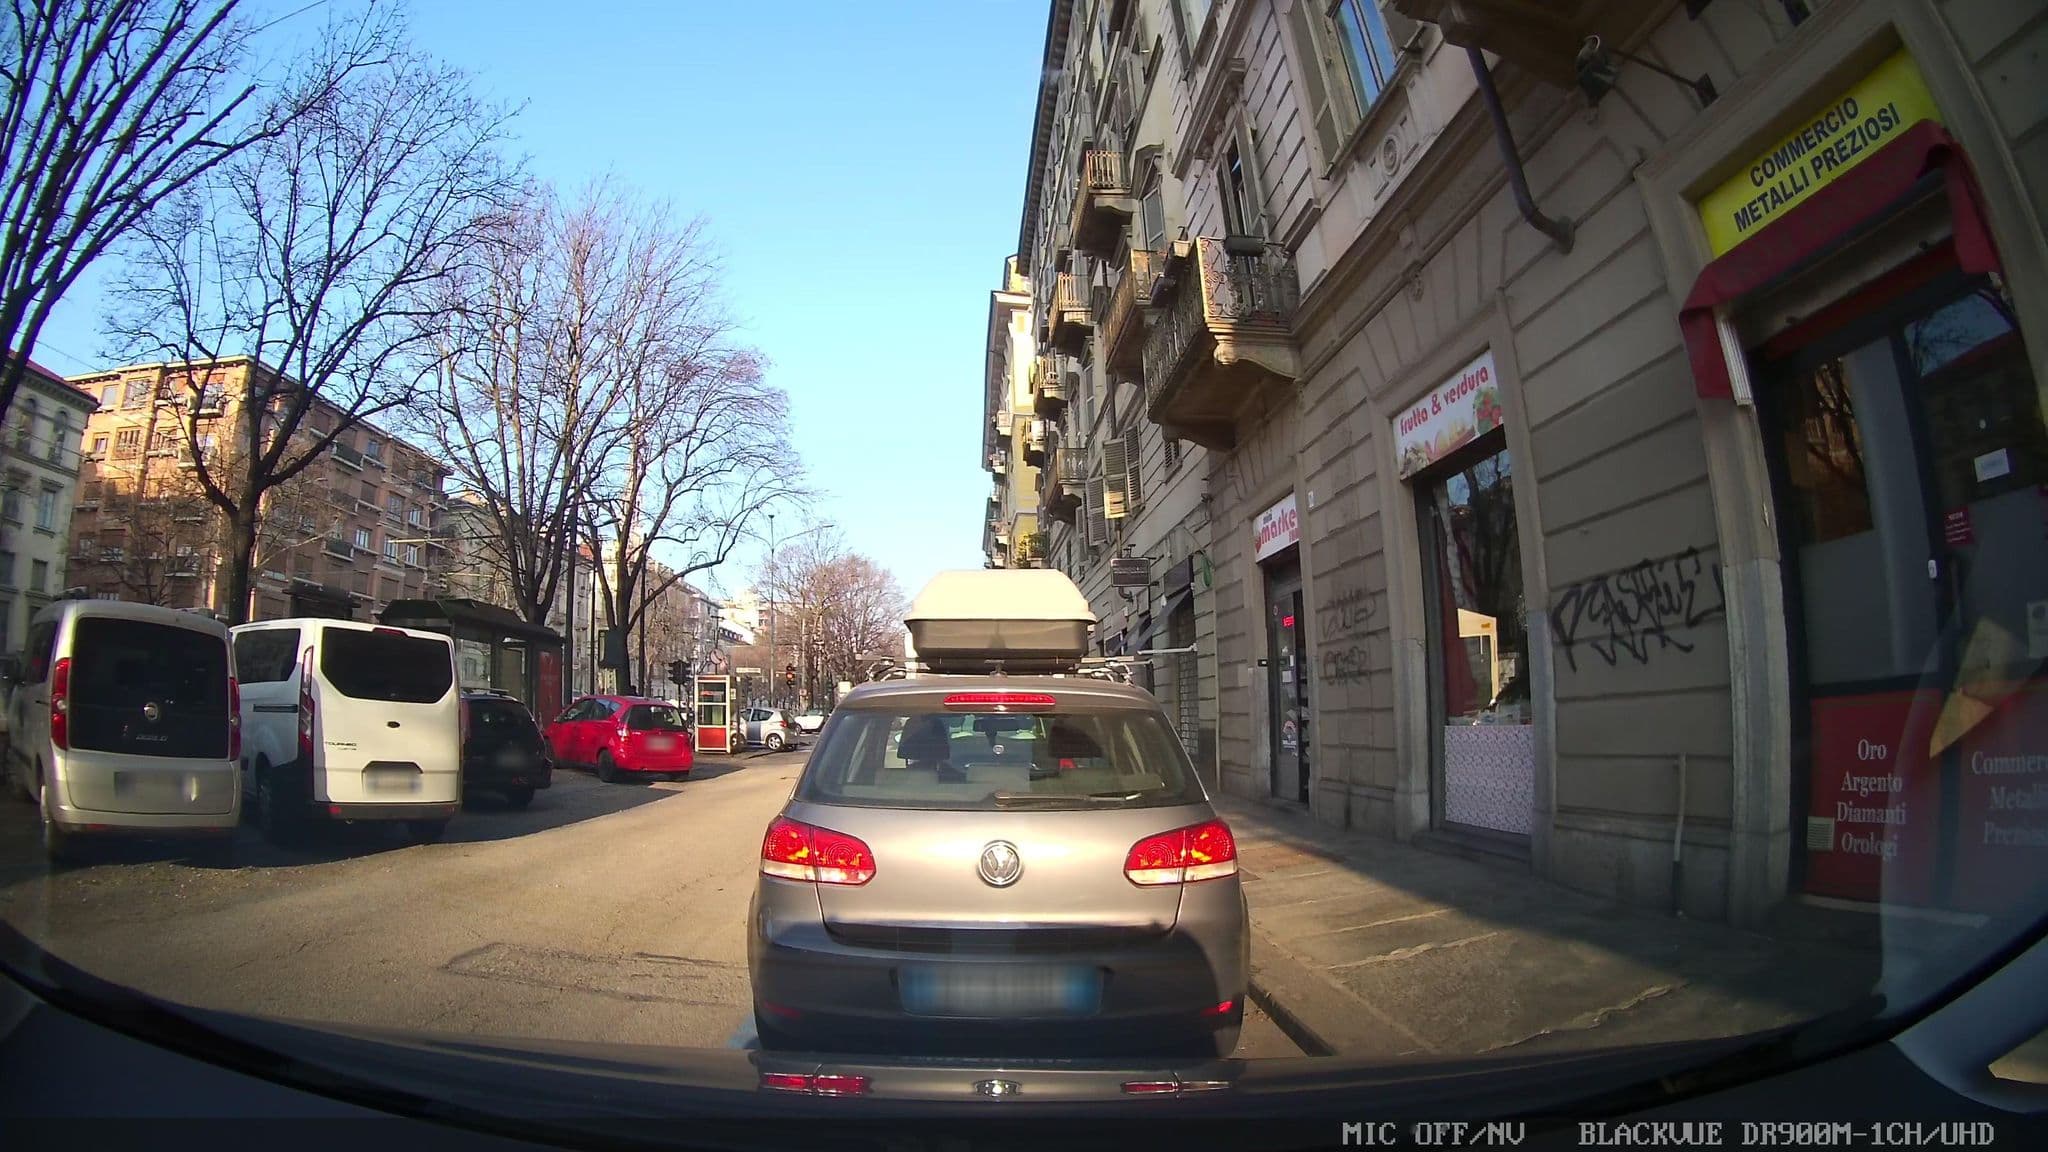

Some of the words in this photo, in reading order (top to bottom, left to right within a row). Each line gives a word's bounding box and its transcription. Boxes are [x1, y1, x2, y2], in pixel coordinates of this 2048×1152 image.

[1750, 97, 1859, 188] COMMERCIO
[1733, 166, 1810, 232] METALLI
[1810, 102, 1900, 180] PREZIOSI
[1400, 407, 1428, 436] frutta
[1431, 393, 1441, 415] &
[1443, 366, 1489, 406] verdura
[1857, 738, 1887, 761] Oro
[1841, 770, 1903, 797] Argento
[1836, 801, 1906, 825] Diamanti
[1841, 831, 1899, 862] Orologi
